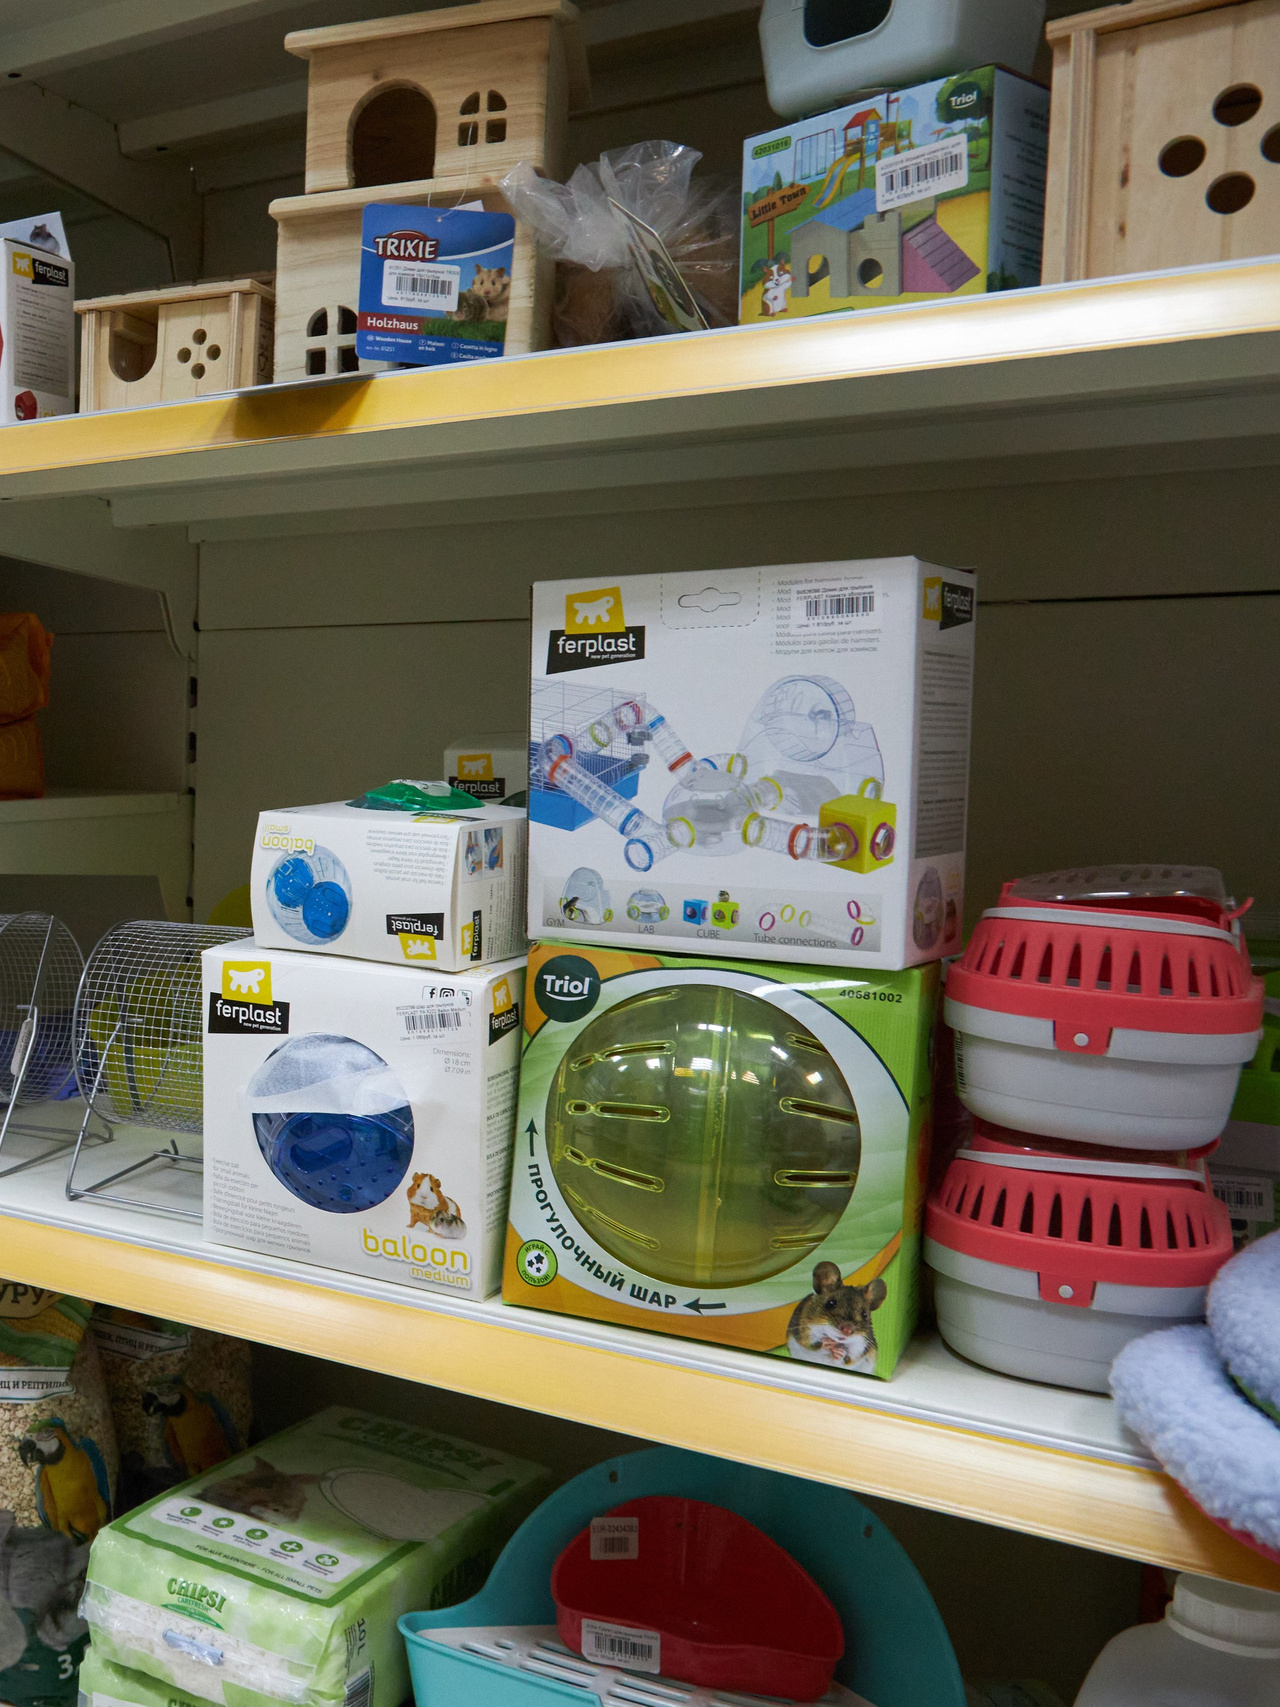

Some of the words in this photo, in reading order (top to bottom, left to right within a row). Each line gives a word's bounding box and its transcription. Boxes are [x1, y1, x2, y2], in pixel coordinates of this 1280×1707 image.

[950, 90, 978, 107] Triol
[752, 200, 778, 221] Little
[780, 186, 807, 207] Town
[375, 237, 437, 259] TRIXIE
[35, 261, 67, 280] ferplast
[367, 316, 419, 330] Holzhaus
[557, 632, 636, 657] ferplast
[453, 780, 500, 794] ferplast
[264, 824, 290, 833] small
[262, 834, 313, 854] baloon
[391, 919, 439, 937] ferplast
[546, 917, 565, 928] GYM
[638, 924, 655, 934] LAB
[472, 914, 480, 957] ferplast
[697, 929, 721, 940] CUBE
[753, 932, 776, 943] Tube
[779, 936, 837, 949] connections
[542, 973, 590, 997] Triol
[839, 989, 903, 1004] 40681002
[215, 999, 282, 1025] ferplast
[491, 1009, 518, 1029] ferplast
[528, 1162, 625, 1299] ПРОГУЛОЧНЫЙ
[627, 1283, 678, 1309] ШАР
[362, 1230, 468, 1271] baloon
[524, 1243, 545, 1253] ИГРАЙ
[411, 1265, 469, 1288] medium
[12, 1380, 20, 1389] И
[166, 1577, 227, 1613] CHIPSI
